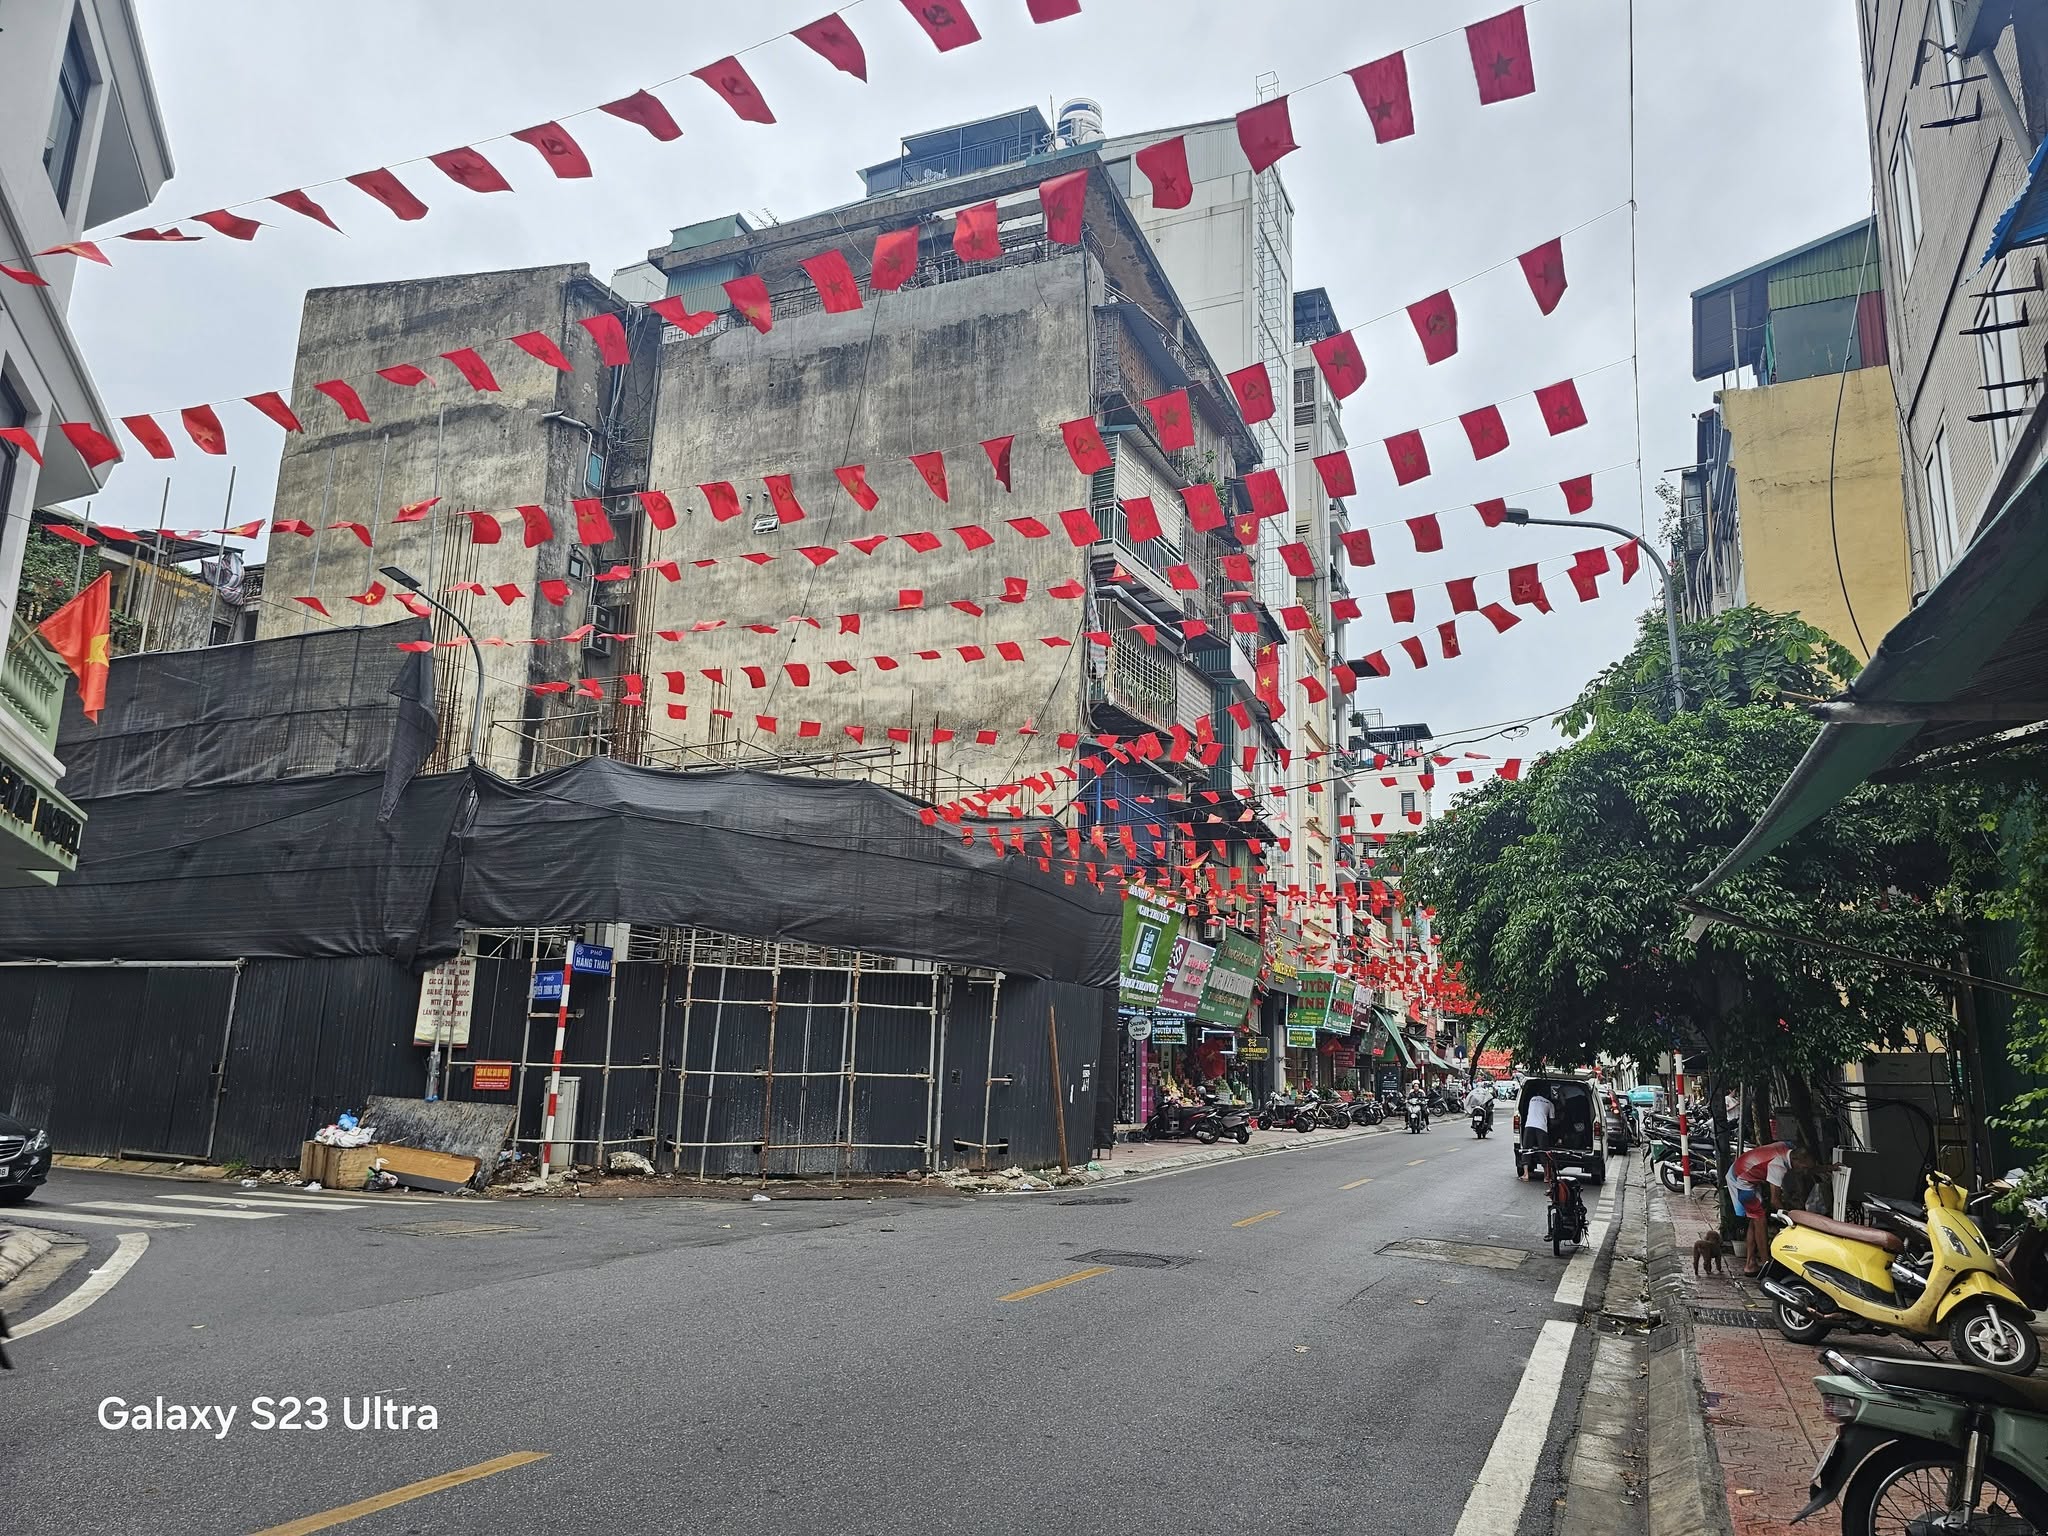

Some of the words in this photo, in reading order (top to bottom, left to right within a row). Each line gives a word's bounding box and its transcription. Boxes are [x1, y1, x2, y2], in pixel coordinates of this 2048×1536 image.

[575, 955, 593, 968] HÀNG
[593, 959, 610, 971] THAN
[1301, 977, 1331, 993] UYÊN
[1288, 1011, 1298, 1019] 69
